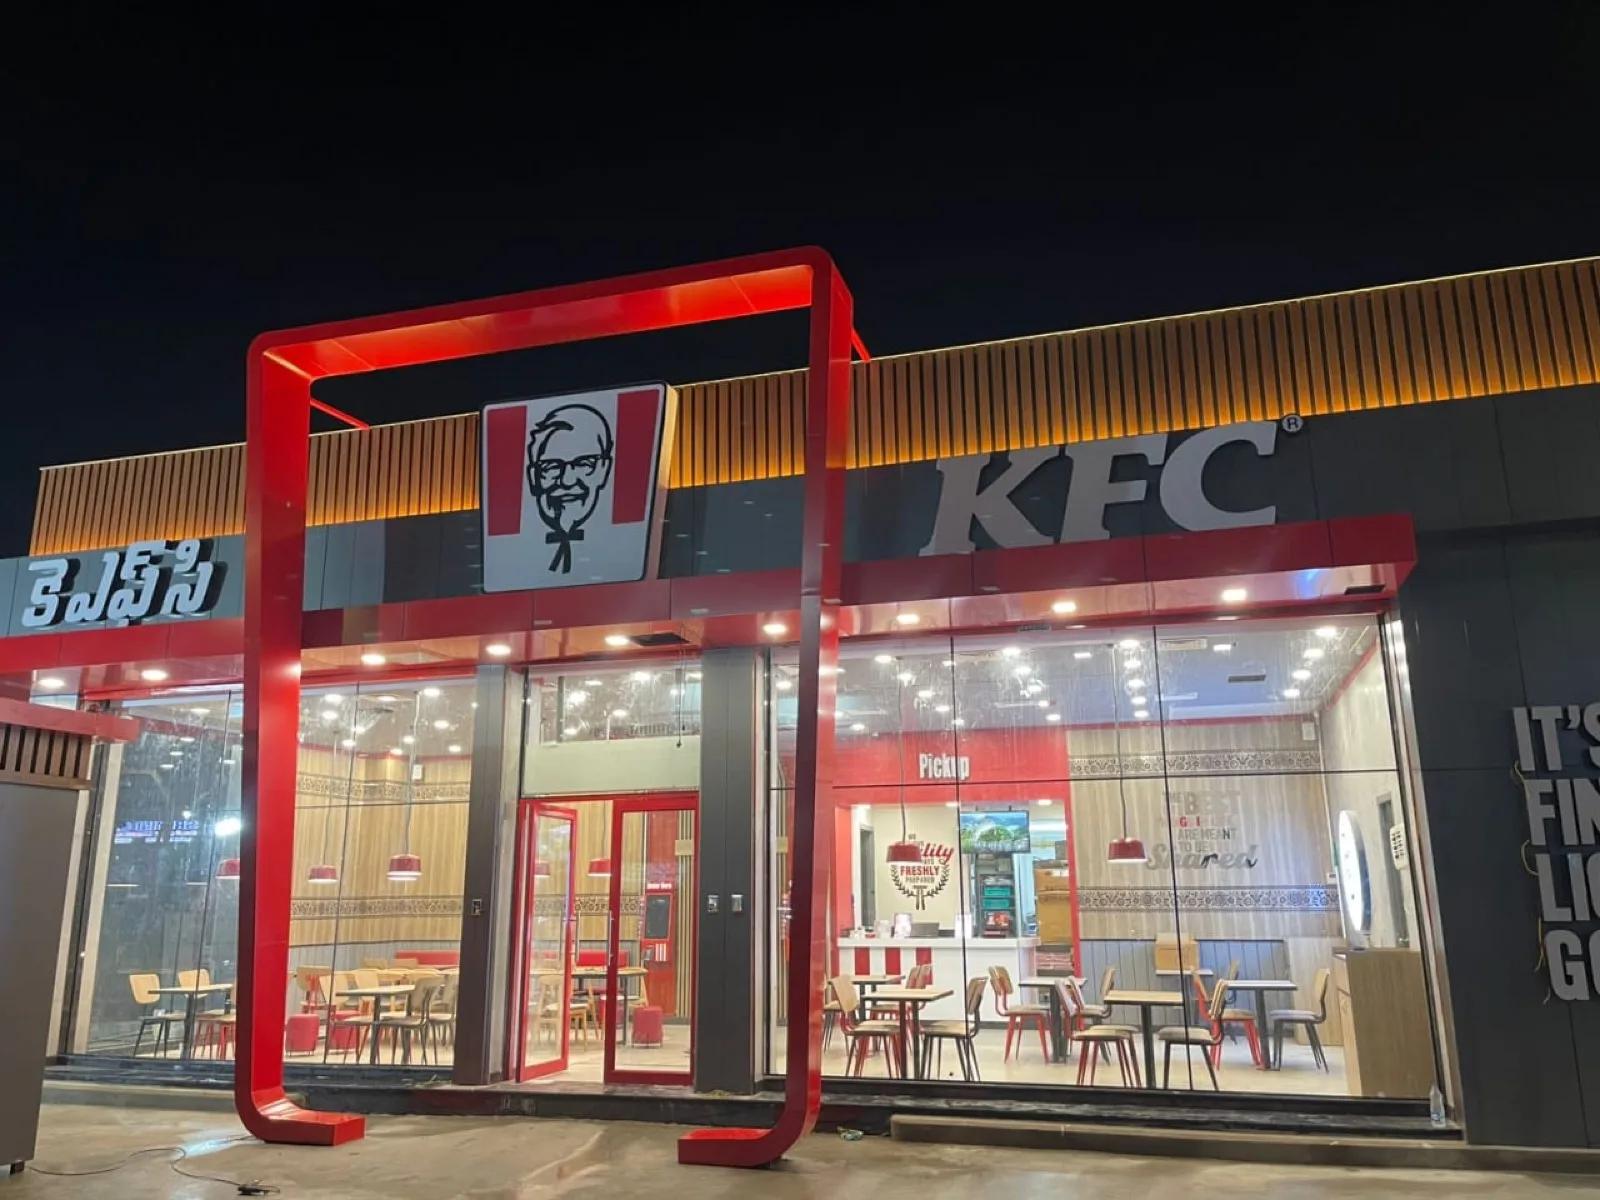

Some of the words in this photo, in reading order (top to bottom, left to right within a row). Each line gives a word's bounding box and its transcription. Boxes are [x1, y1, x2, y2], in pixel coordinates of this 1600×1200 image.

[918, 420, 1278, 556] KFC
[900, 865, 939, 876] FRESHLY
[1544, 929, 1600, 1001] G
